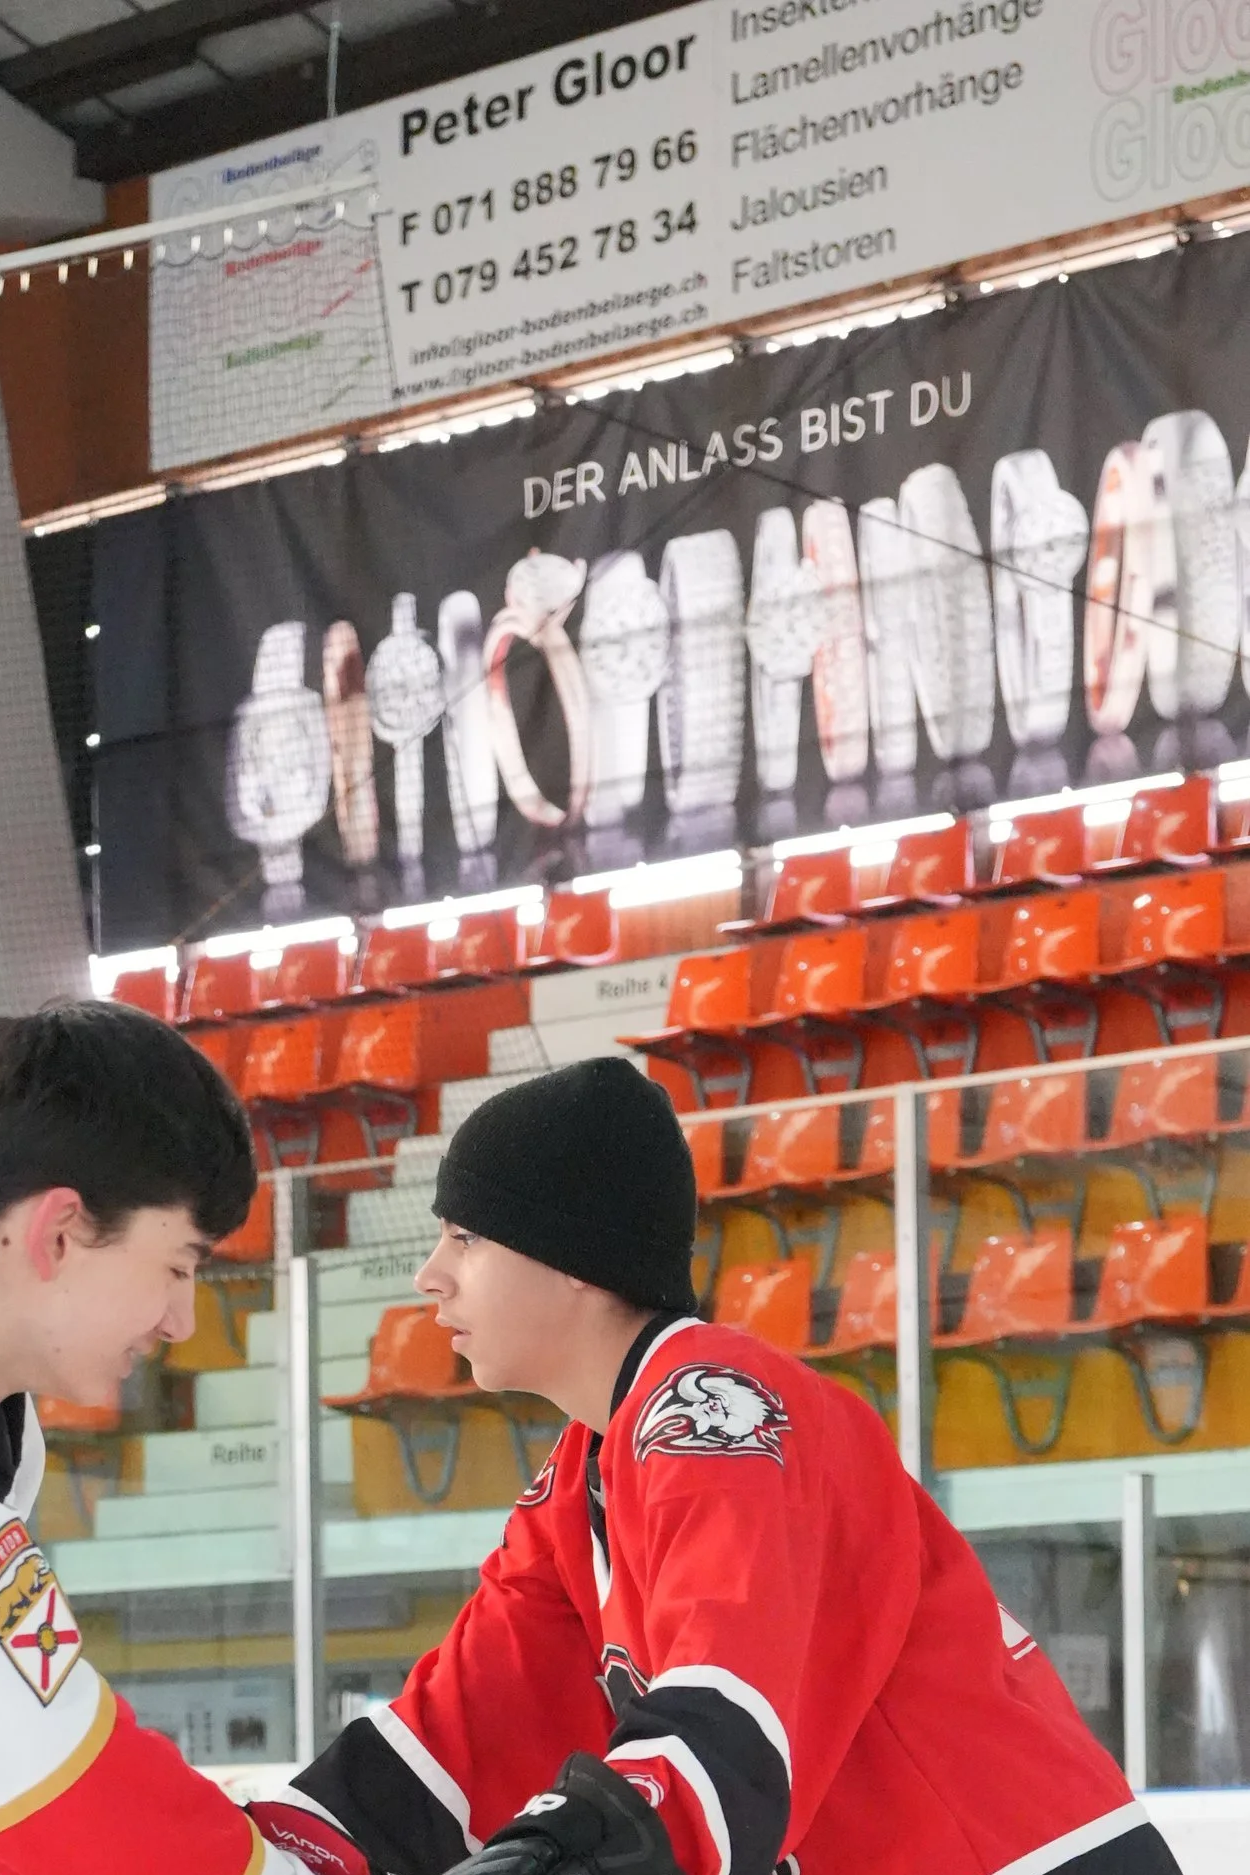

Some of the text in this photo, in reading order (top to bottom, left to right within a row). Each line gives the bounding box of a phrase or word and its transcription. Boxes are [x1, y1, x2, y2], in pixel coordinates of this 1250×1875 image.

[400, 33, 697, 157] Peter Gloor
[731, 0, 1044, 106] Lamellenvorhänge
[731, 61, 1025, 168] Flächenvorhänge
[401, 129, 697, 246] F 071 888 79 66
[730, 162, 889, 232] Jalousien
[401, 200, 698, 313] T 079 452 78 34
[731, 224, 897, 294] Faltstoren
[523, 371, 972, 519] DER ANLASS BIST DU
[269, 1821, 351, 1875] VAPOR
